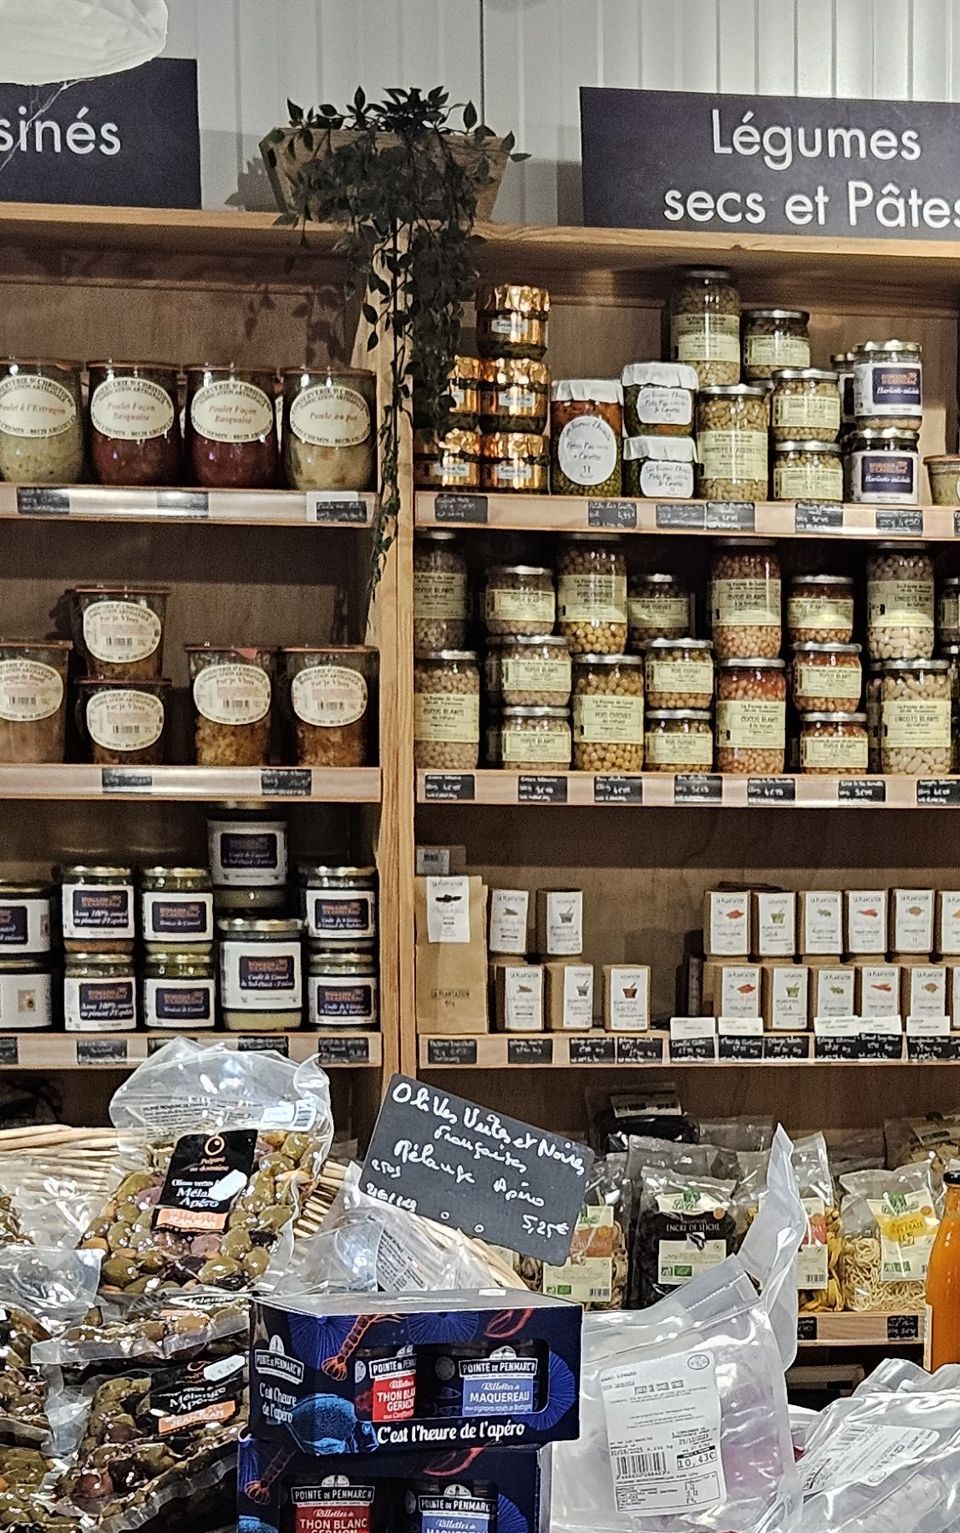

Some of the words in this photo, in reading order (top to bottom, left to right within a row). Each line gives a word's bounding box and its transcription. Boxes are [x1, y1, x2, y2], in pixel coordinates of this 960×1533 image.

[0, 105, 121, 156] sinés
[712, 109, 921, 170] Légumes
[664, 188, 766, 225] secs
[785, 186, 828, 225] et
[176, 1186, 211, 1198] Méla
[179, 1196, 220, 1208] Apéro
[373, 1361, 397, 1374] POINTE
[463, 1362, 491, 1373] POINTE
[377, 1391, 403, 1402] THON
[403, 1388, 416, 1400] BLA
[469, 1391, 530, 1403] MAQUEREAU
[377, 1426, 408, 1444] C'est
[411, 1425, 456, 1442] l'heure
[459, 1423, 476, 1440] de
[479, 1420, 525, 1441] l'apéro
[678, 1452, 715, 1468] 10,43€
[294, 1490, 321, 1500] POINTE
[421, 1500, 445, 1509] POINTE
[300, 1519, 330, 1530] THON
[333, 1519, 368, 1529] BLANC
